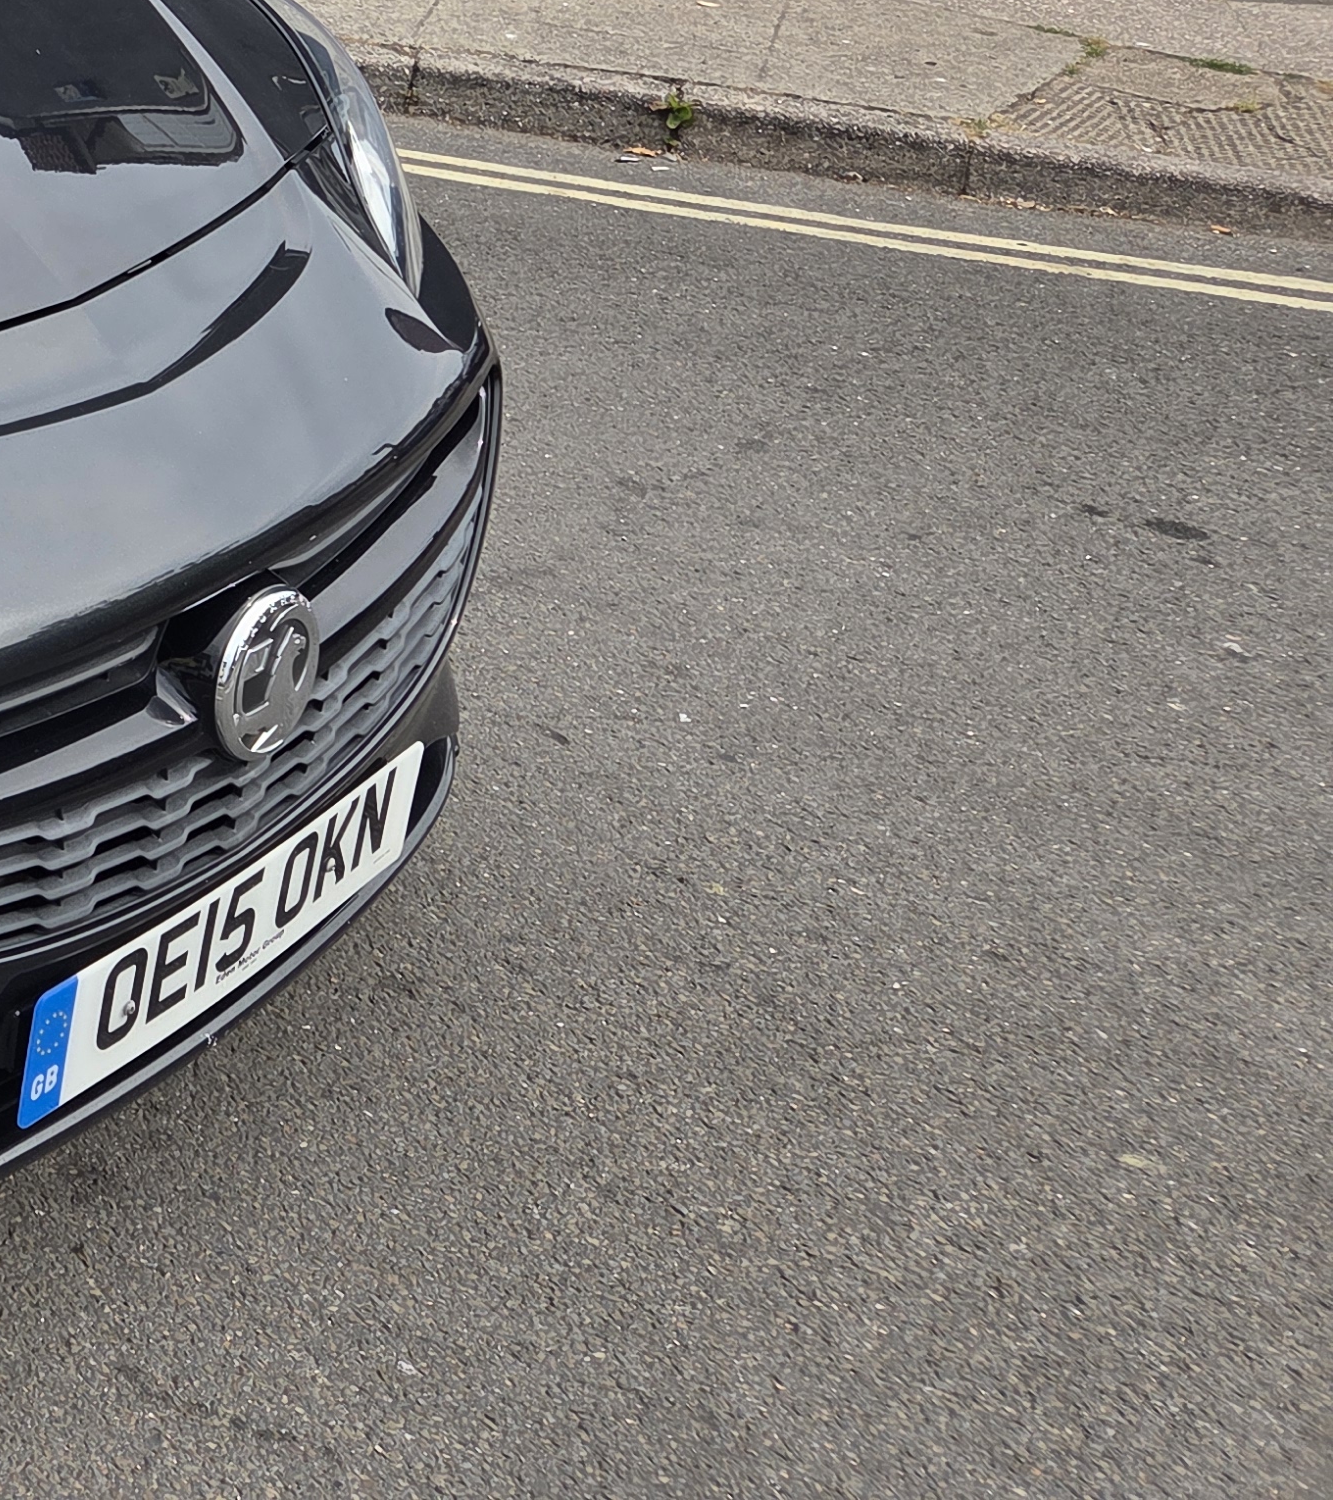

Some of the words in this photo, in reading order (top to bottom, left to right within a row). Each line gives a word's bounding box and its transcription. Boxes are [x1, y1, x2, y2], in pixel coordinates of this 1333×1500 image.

[95, 867, 264, 1051] OE15
[274, 765, 398, 933] OKN
[215, 966, 236, 985] Eden
[238, 946, 261, 969] Motor
[262, 928, 285, 950] Group
[29, 1063, 59, 1102] GB
